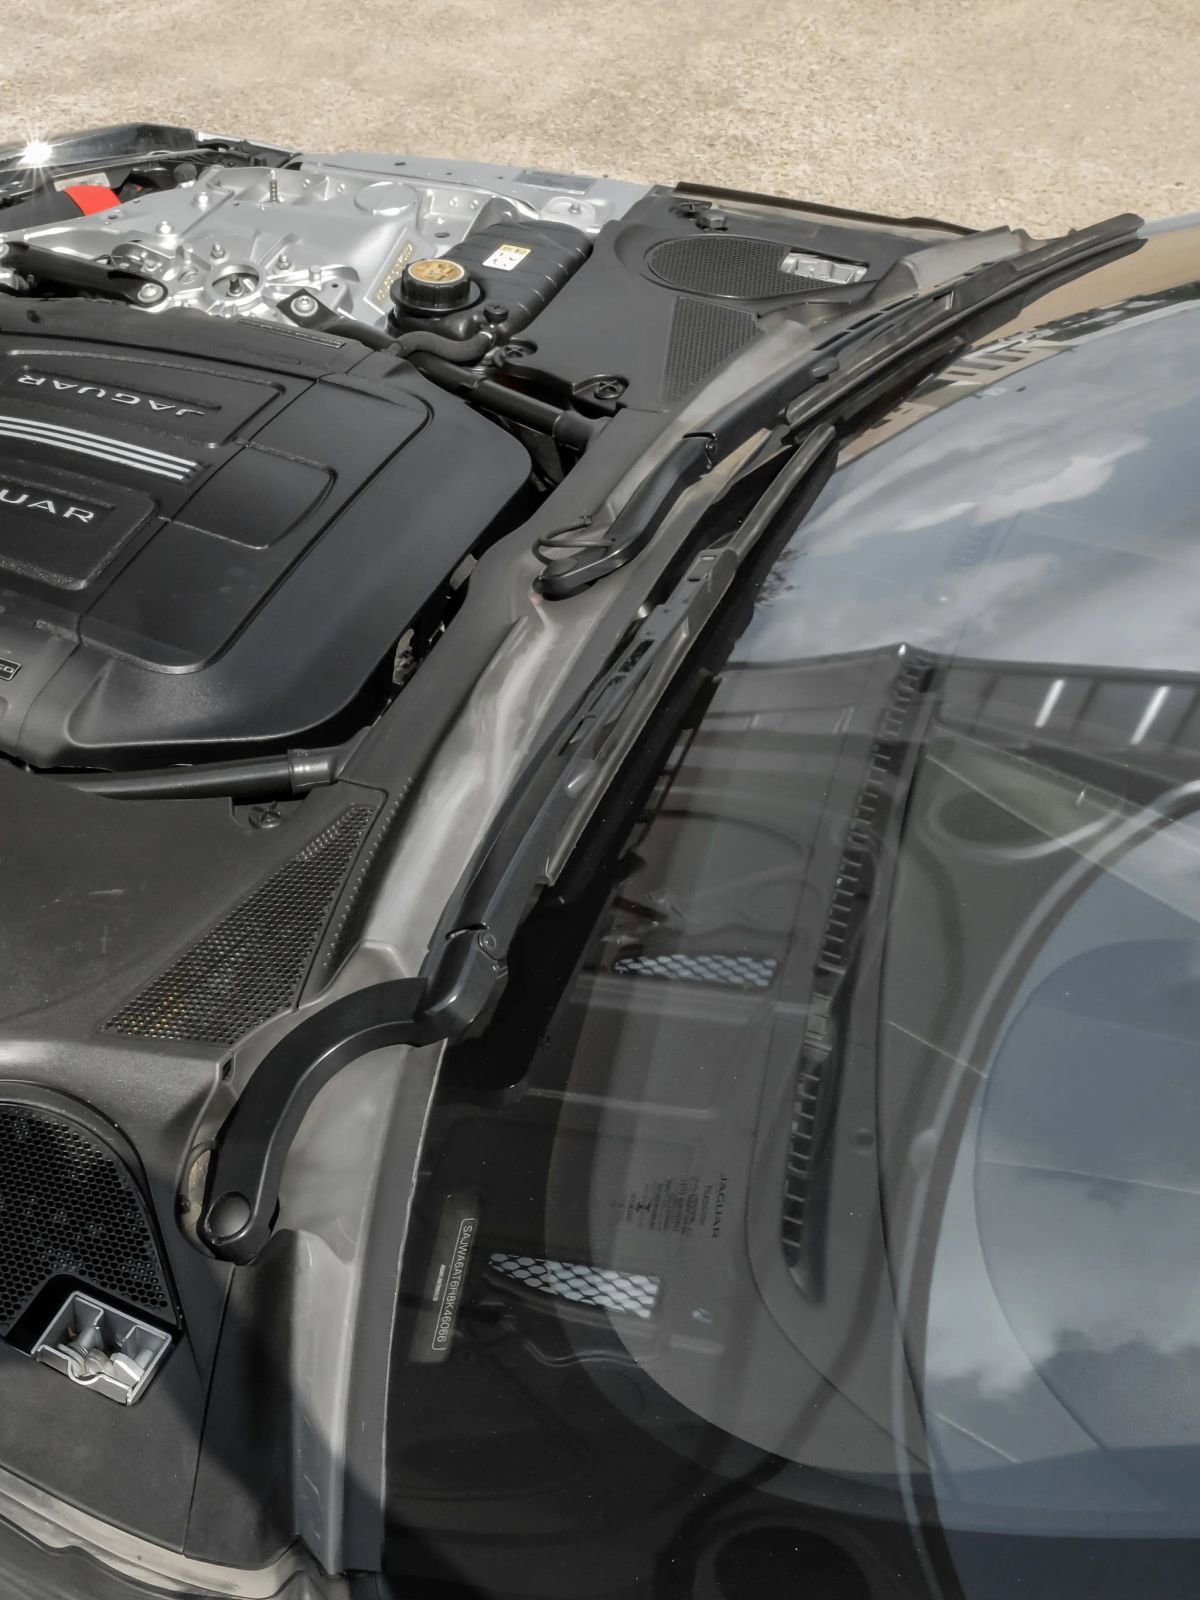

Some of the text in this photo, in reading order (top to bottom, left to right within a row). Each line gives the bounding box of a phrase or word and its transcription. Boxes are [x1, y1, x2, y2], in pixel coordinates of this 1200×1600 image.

[17, 374, 205, 416] JAGUAR
[712, 1173, 727, 1238] JAGUAR
[437, 1225, 473, 1343] SAJWA6AT6H8K46066
